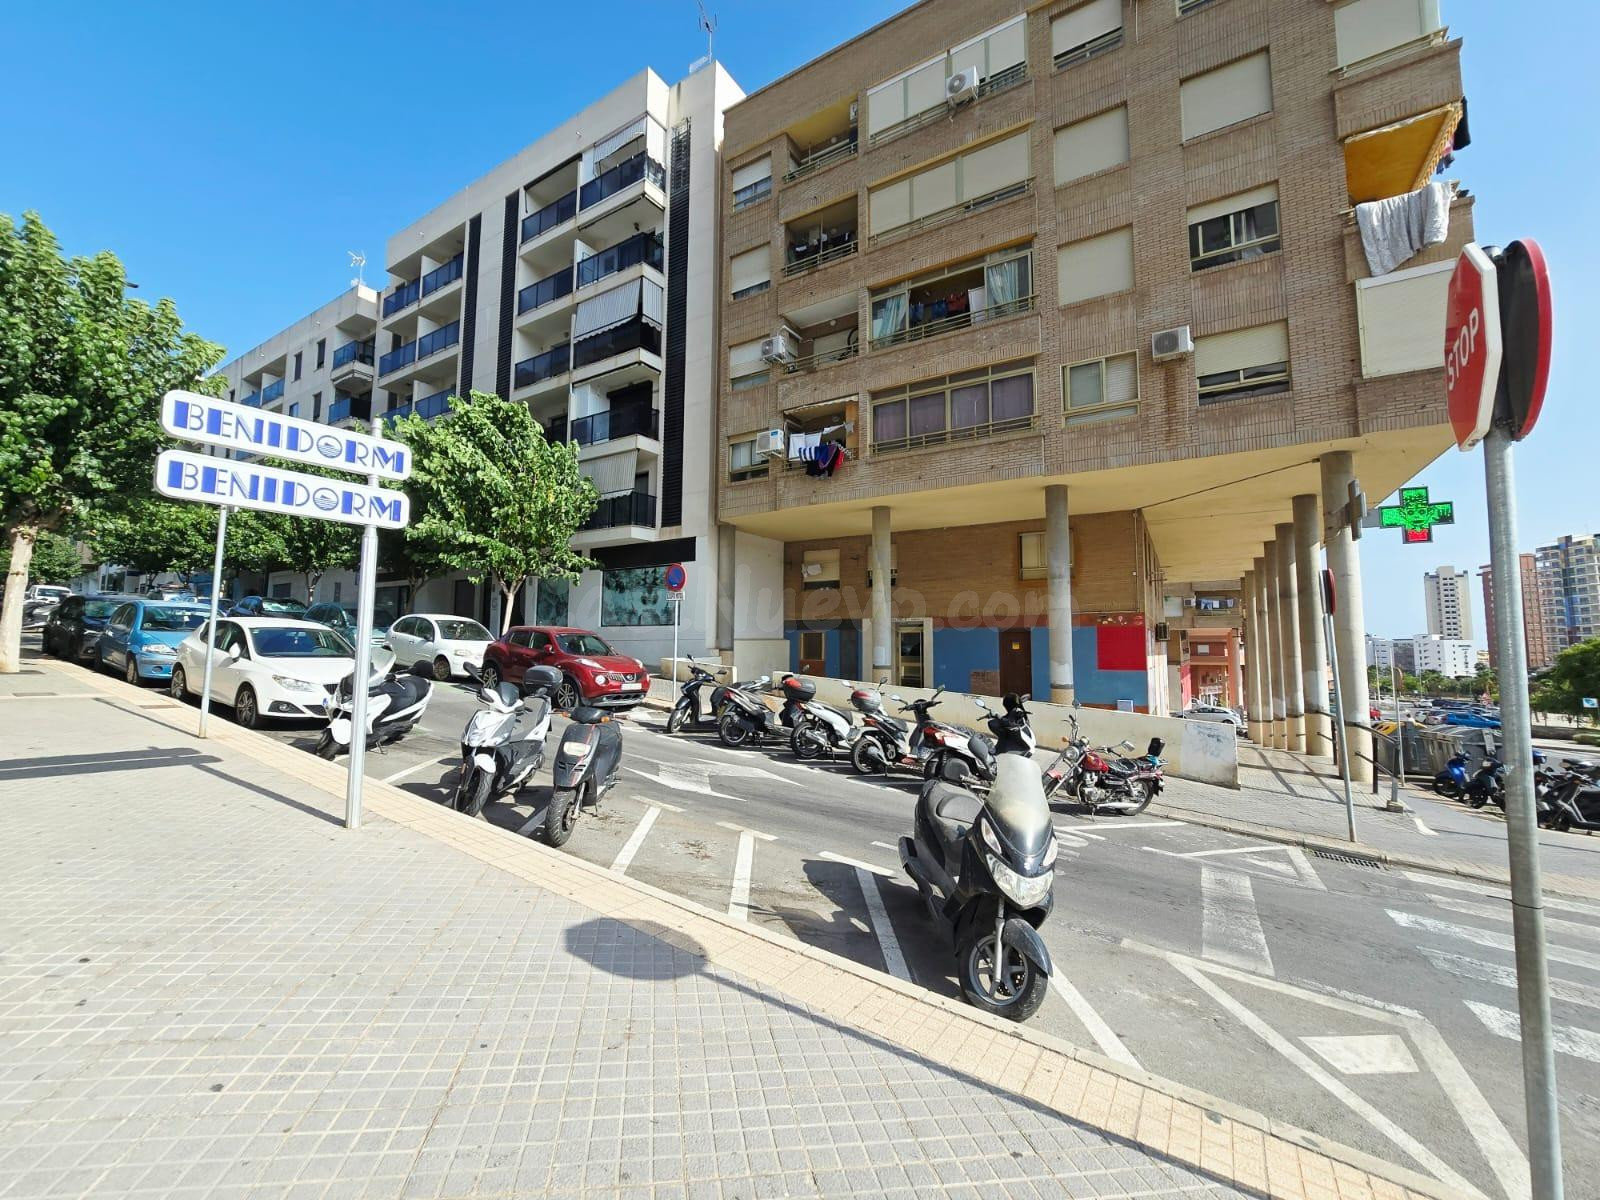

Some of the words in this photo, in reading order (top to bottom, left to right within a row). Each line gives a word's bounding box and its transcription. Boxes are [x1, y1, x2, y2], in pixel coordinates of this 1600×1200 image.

[1448, 307, 1478, 391] STOP
[173, 400, 404, 473] BENIDORM
[167, 460, 402, 522] BENIDORM
